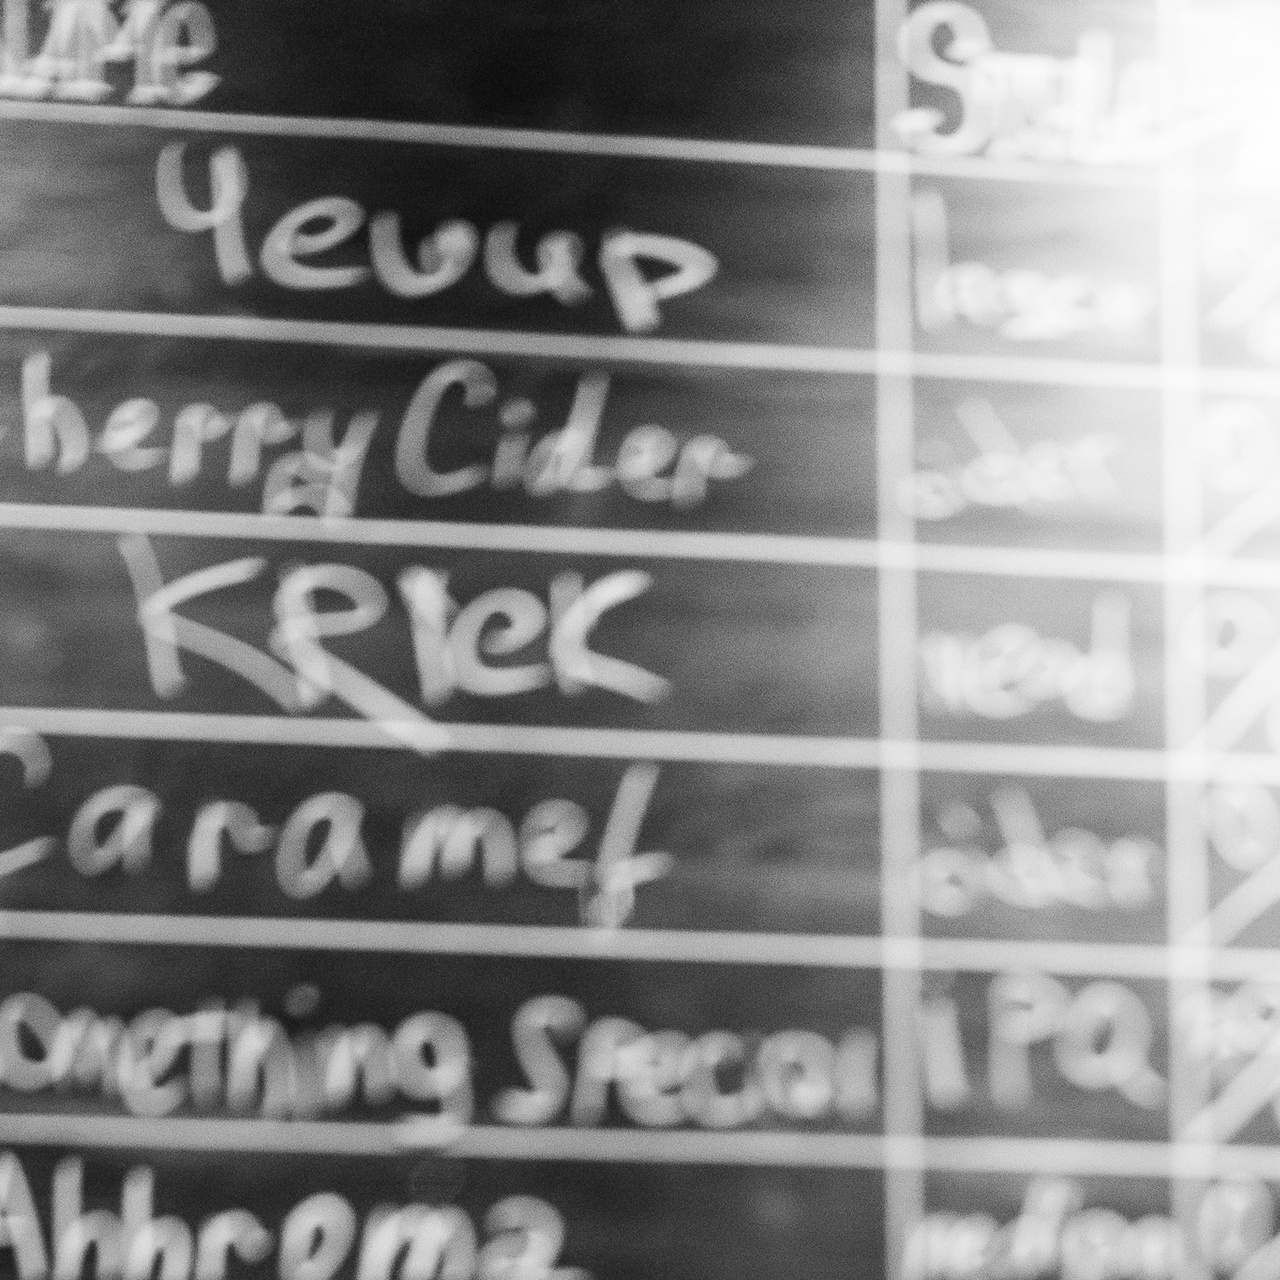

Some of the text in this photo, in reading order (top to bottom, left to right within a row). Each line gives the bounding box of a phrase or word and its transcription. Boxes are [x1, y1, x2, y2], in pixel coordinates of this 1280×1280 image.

[18, 350, 754, 526] herry Cider
[0, 985, 474, 1150] omething
